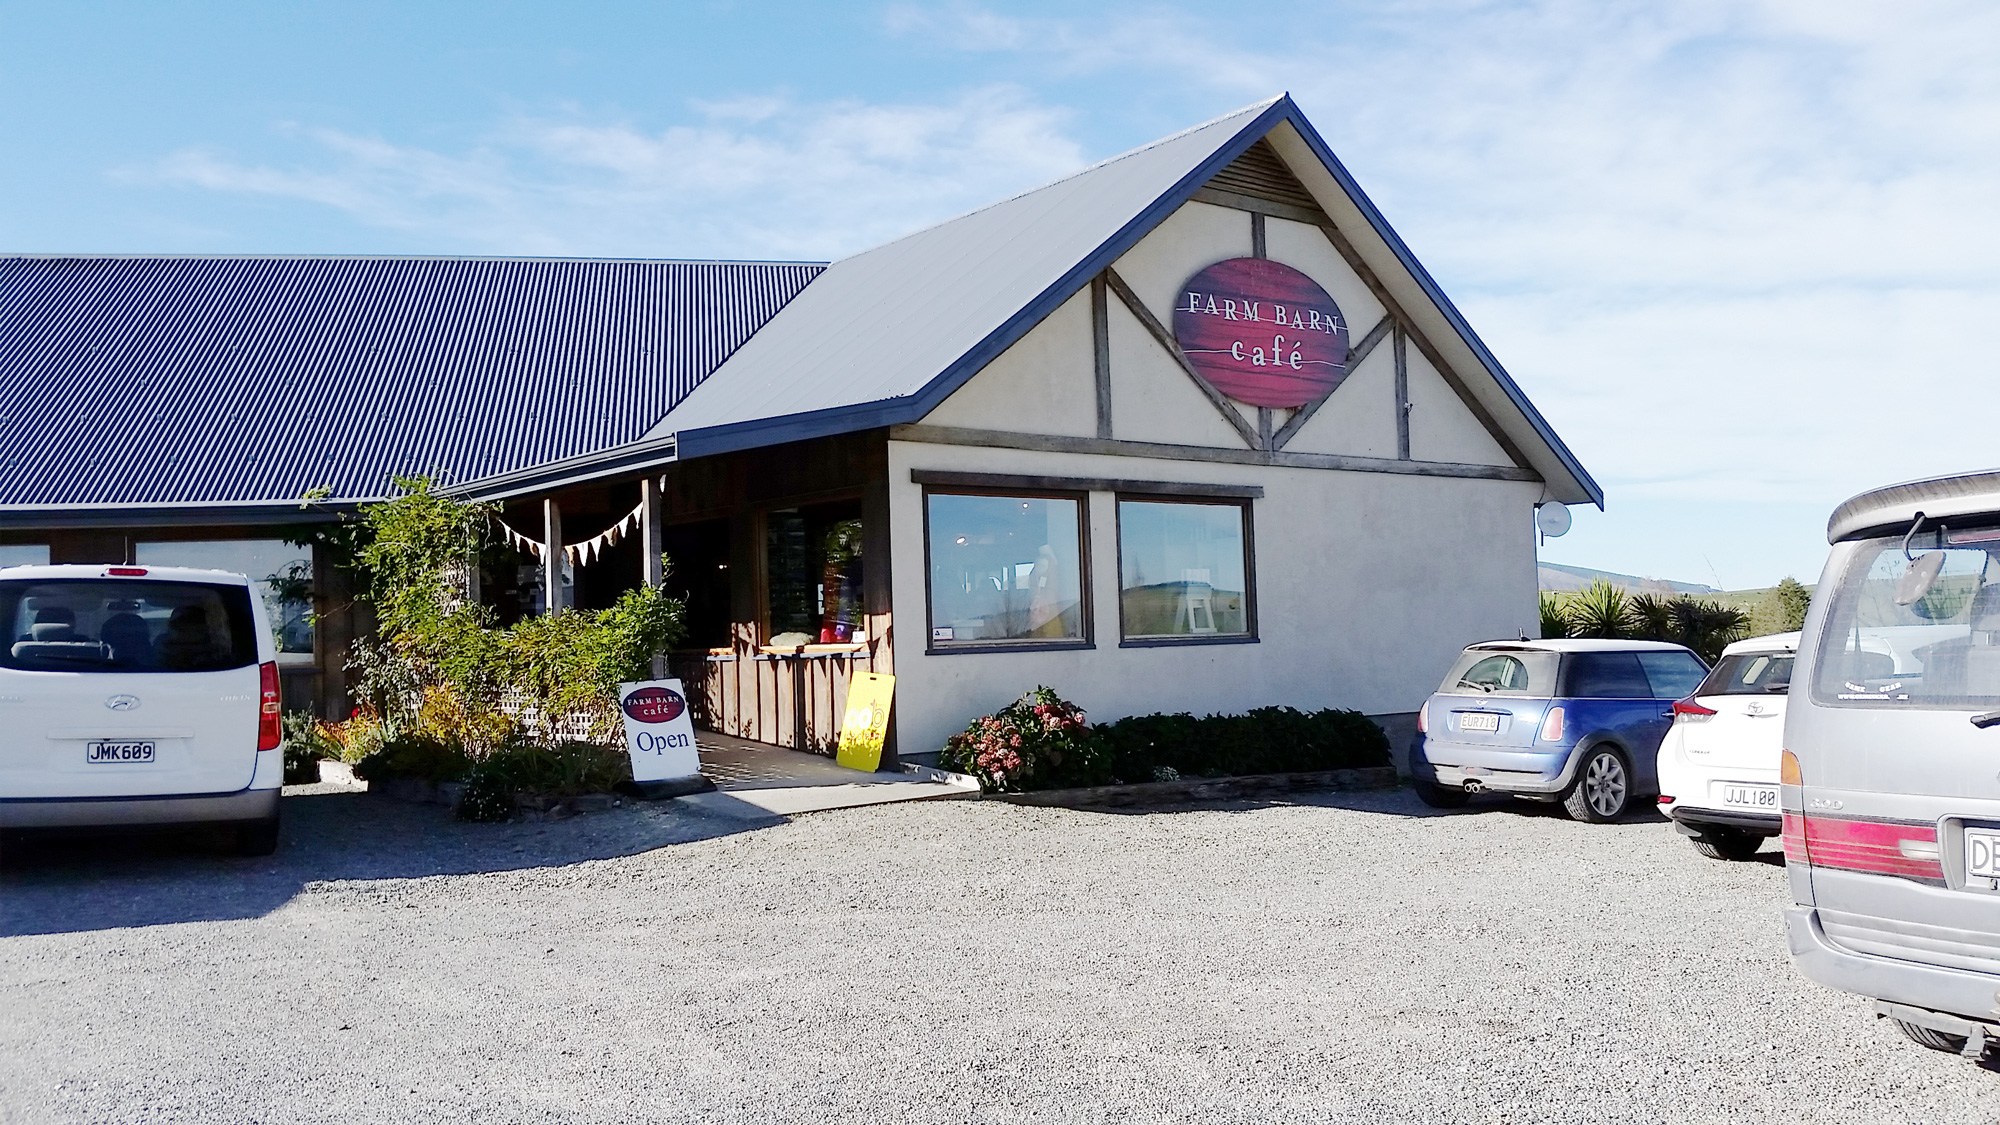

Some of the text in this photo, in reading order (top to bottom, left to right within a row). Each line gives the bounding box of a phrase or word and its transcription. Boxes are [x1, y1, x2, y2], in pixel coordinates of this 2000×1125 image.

[1187, 291, 1339, 336] FARM BARN
[1231, 334, 1303, 370] café
[627, 695, 680, 706] FARM BARN
[643, 704, 669, 716] café
[1462, 715, 1497, 728] EUR718
[636, 731, 690, 756] Open
[90, 745, 153, 761] JMK609
[1726, 788, 1776, 806] JJL100
